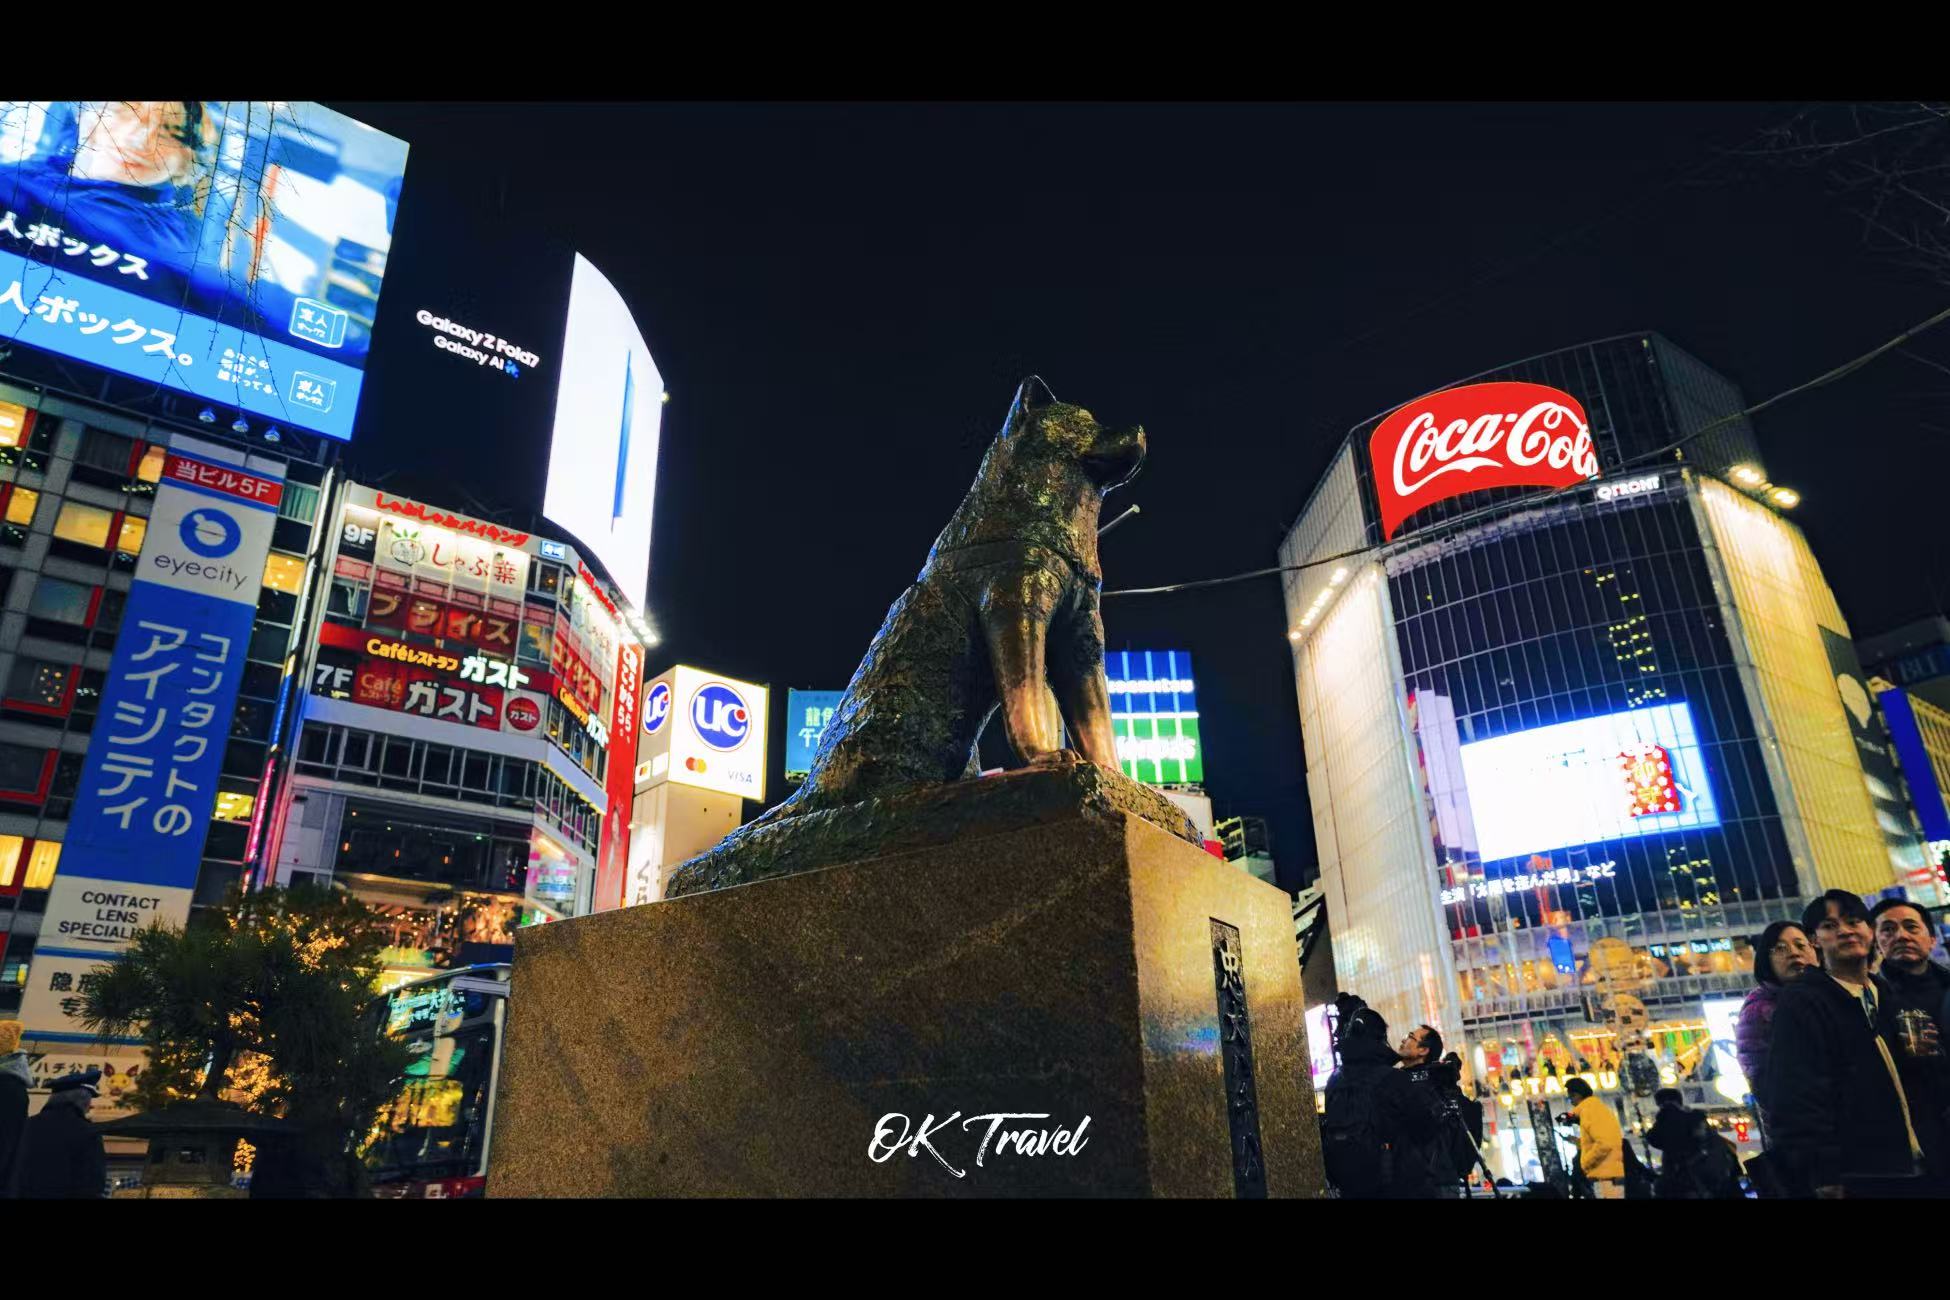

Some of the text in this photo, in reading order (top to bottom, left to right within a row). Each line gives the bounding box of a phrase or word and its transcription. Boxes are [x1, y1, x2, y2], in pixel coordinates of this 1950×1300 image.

[0, 280, 193, 366] 人ボックス。
[416, 309, 483, 346] Galaxy
[496, 338, 540, 368] Fold7
[434, 335, 505, 371] Galaxy AI
[1393, 401, 1600, 497] Coca-Cola
[176, 461, 271, 497] 当ビル5F
[344, 523, 377, 546] 9F
[154, 555, 247, 590] eyecity
[315, 663, 354, 688] 7F
[459, 655, 531, 691] ガスト
[404, 681, 494, 724] ガスト
[97, 620, 188, 830] アイシティ
[152, 633, 231, 837] コンタクトの
[728, 768, 752, 783] VISA
[81, 890, 160, 911] CONTACT
[95, 909, 139, 924] LENS
[58, 920, 147, 941] SPECIALIS
[34, 1062, 99, 1075] ハチ公
